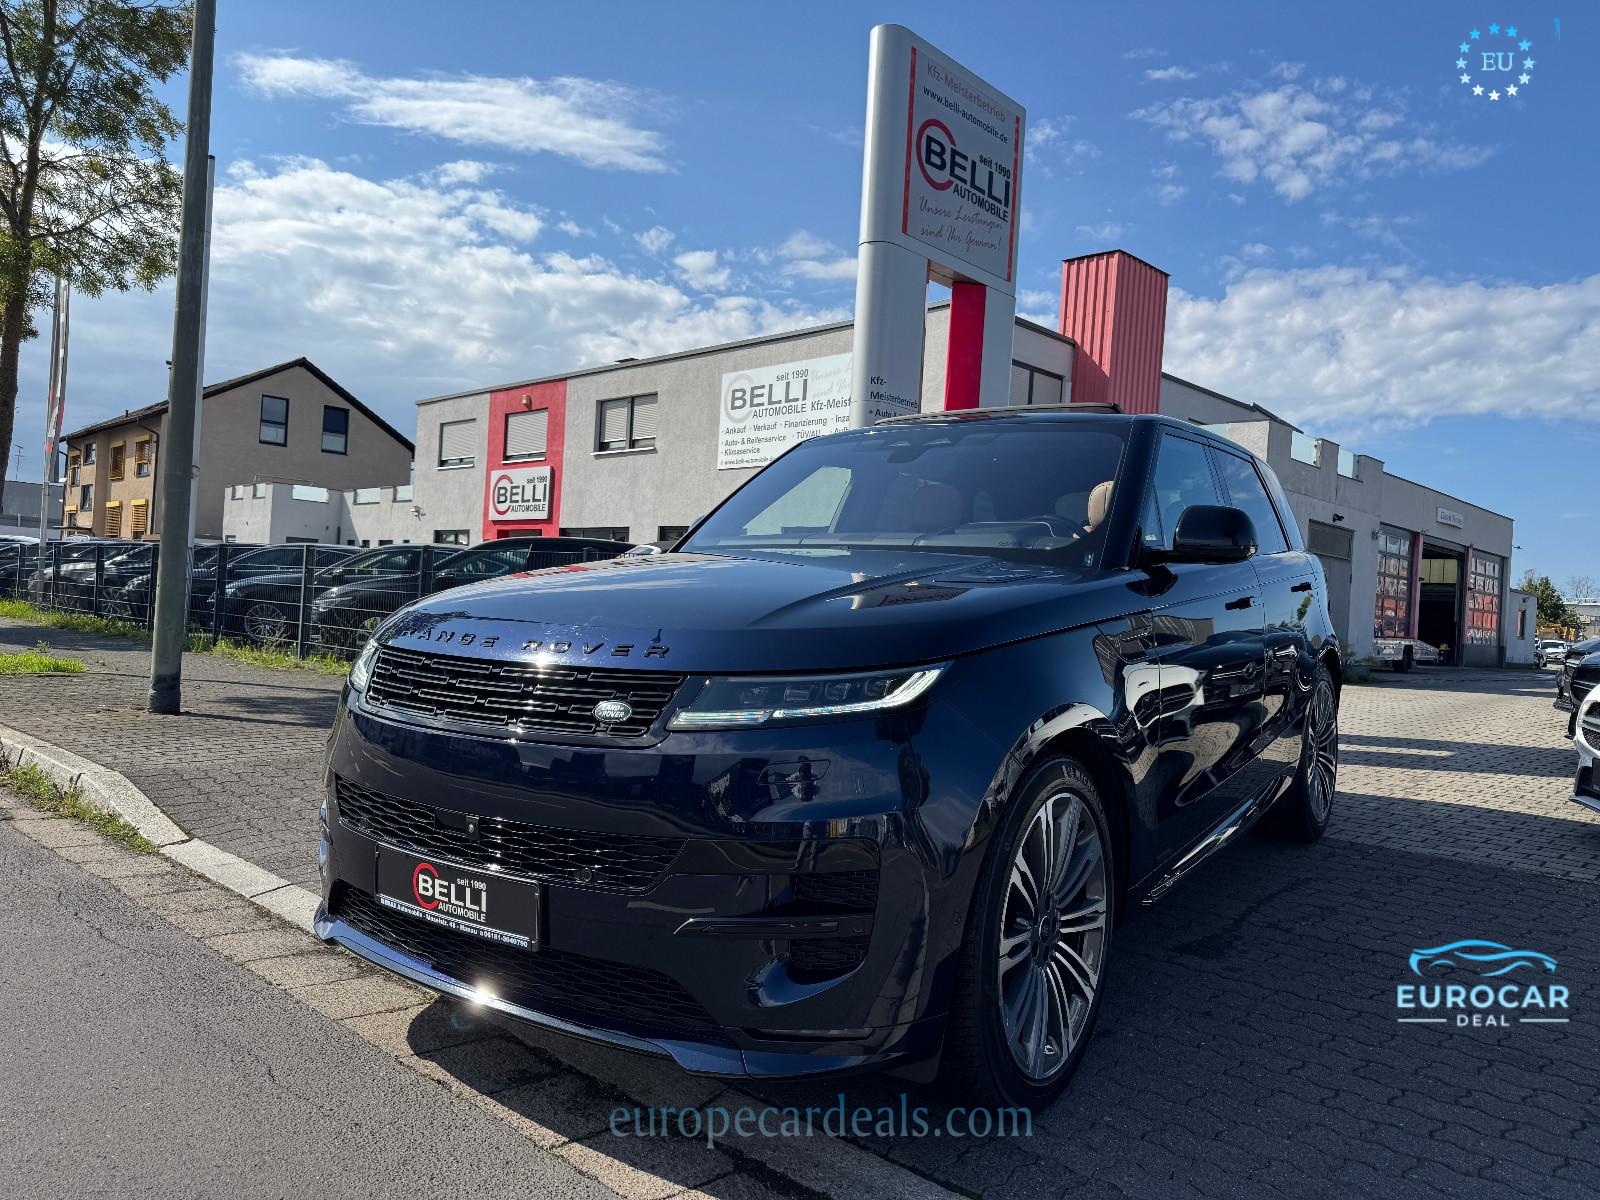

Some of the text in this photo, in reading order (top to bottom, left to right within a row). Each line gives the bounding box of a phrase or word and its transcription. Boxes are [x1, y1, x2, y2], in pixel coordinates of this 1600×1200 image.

[927, 63, 1006, 122] Kfz-Meisterbetrieb
[923, 86, 1008, 144] www.belli-automobile.de
[925, 134, 1011, 208] BELLI
[980, 155, 1011, 179] seit 1990
[952, 183, 1008, 223] AUTOMOBILE
[921, 222, 944, 238] sind
[776, 369, 809, 382] seit 1990
[870, 376, 887, 386] Kfz-
[730, 379, 808, 410] BELLI
[870, 391, 918, 409] Meisterbetrieb
[752, 403, 807, 419] AUTOMOBILE
[725, 425, 747, 435] Ankauf
[753, 422, 777, 432] Verkauf
[784, 417, 828, 428] Finanzierung
[746, 435, 787, 445] Reifenservice
[724, 447, 761, 456] Klimaservice
[536, 475, 548, 483] 1990
[497, 484, 547, 504] BELLI
[511, 503, 546, 512] AUTOMOBILE
[401, 629, 670, 659] RANGE ROVER
[601, 710, 625, 718] ROVER
[418, 873, 487, 912] BELLI
[456, 878, 487, 891] seit 1990
[437, 902, 487, 923] AUTOMOBILE
